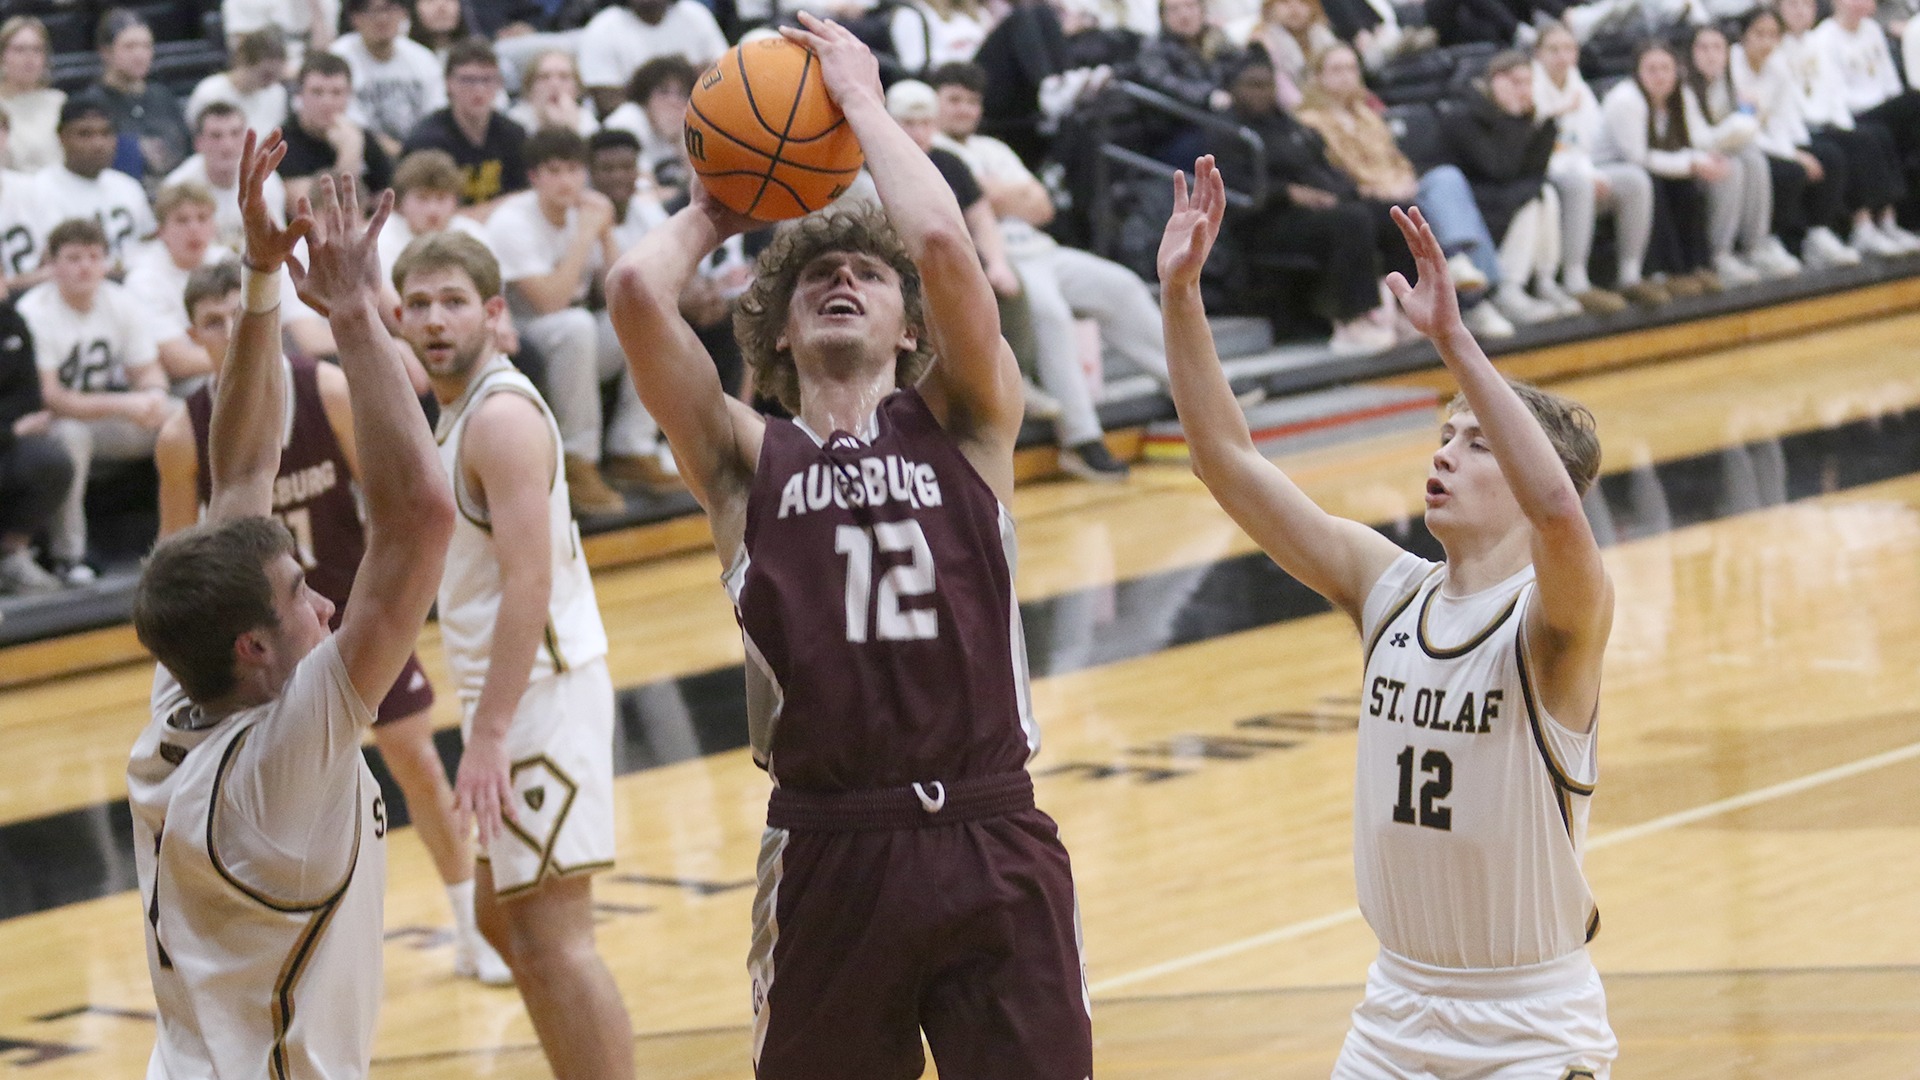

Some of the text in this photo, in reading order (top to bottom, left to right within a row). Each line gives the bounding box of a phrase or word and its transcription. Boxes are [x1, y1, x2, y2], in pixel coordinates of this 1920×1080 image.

[834, 518, 939, 643] 12
[1369, 676, 1504, 734] ST. OLAF
[1392, 745, 1453, 832] 12
